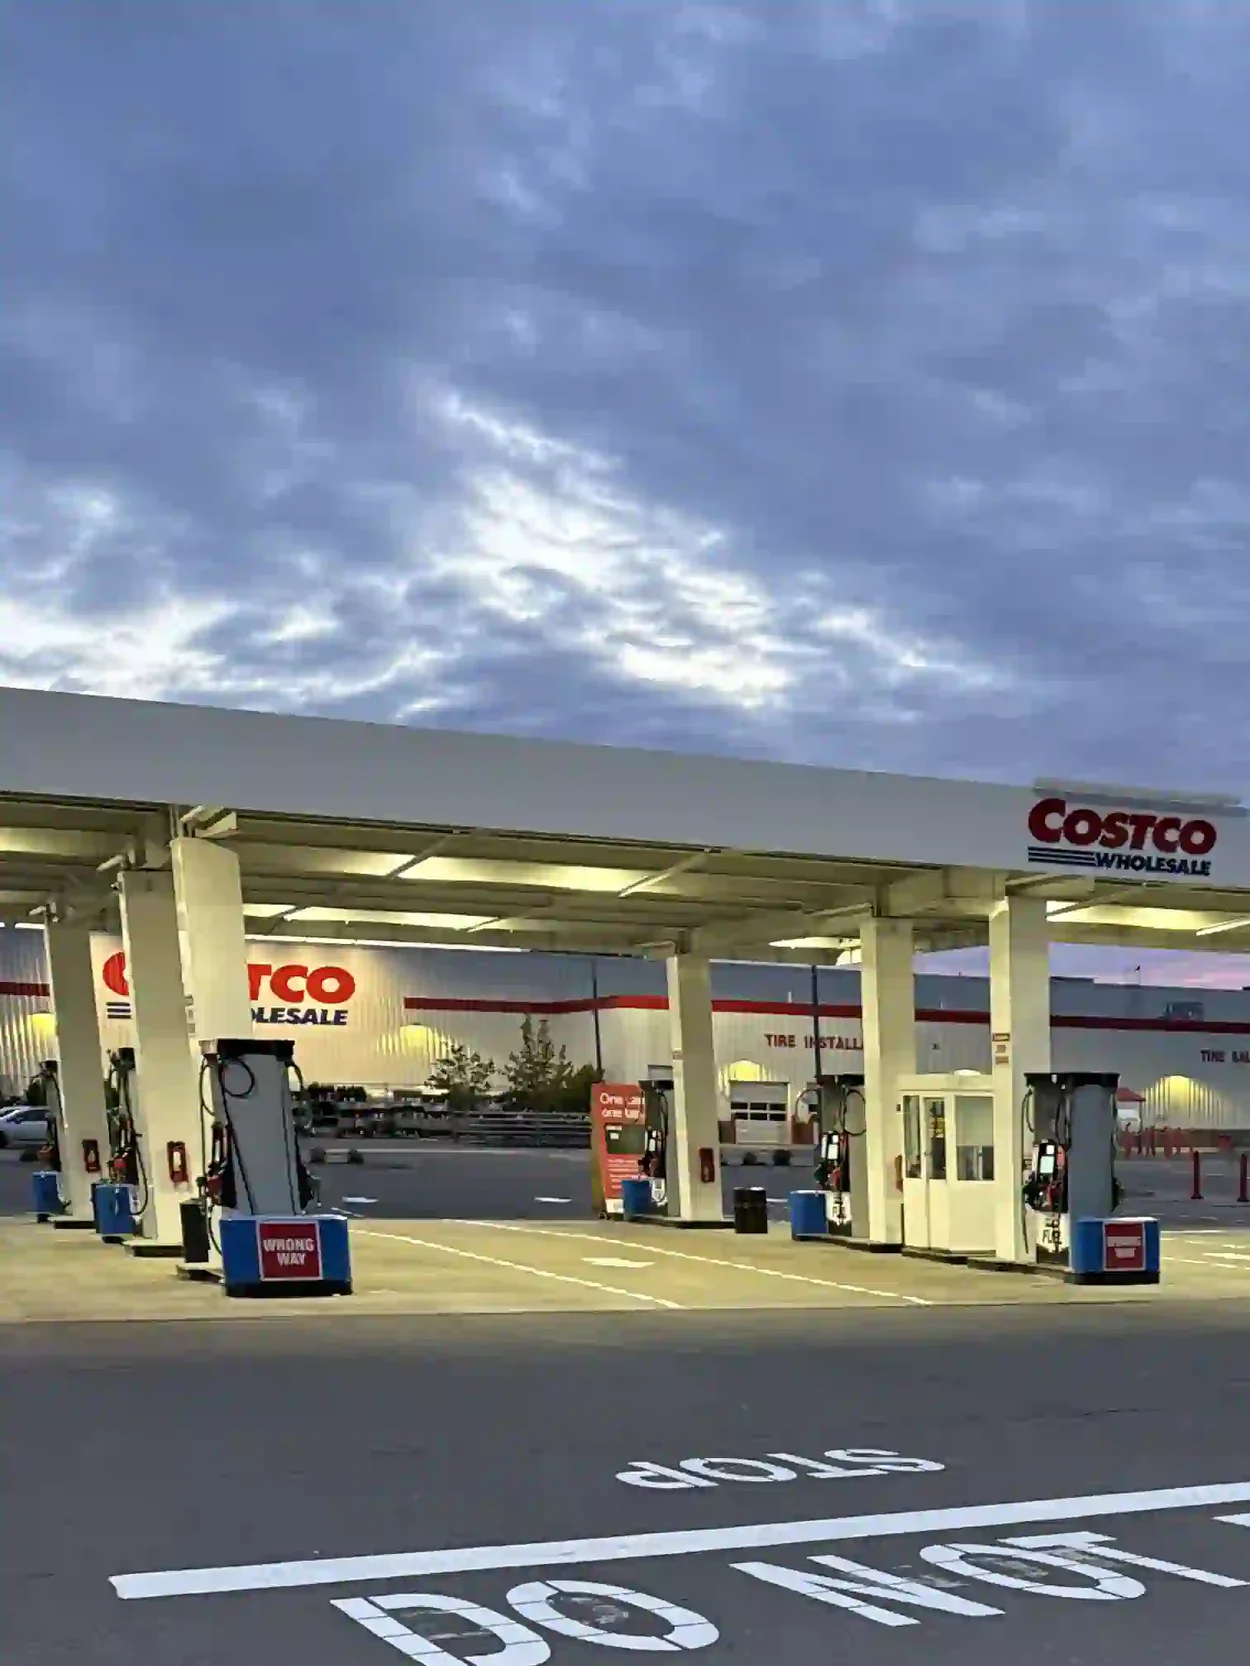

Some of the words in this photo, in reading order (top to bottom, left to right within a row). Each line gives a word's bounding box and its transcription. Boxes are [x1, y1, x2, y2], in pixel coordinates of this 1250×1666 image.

[1028, 798, 1217, 855] COSTCO
[1095, 852, 1212, 877] WHOLESALE
[764, 1034, 797, 1049] TIRE
[263, 1237, 314, 1252] WRONG
[277, 1252, 306, 1266] WAY
[615, 1448, 946, 1489] STOP
